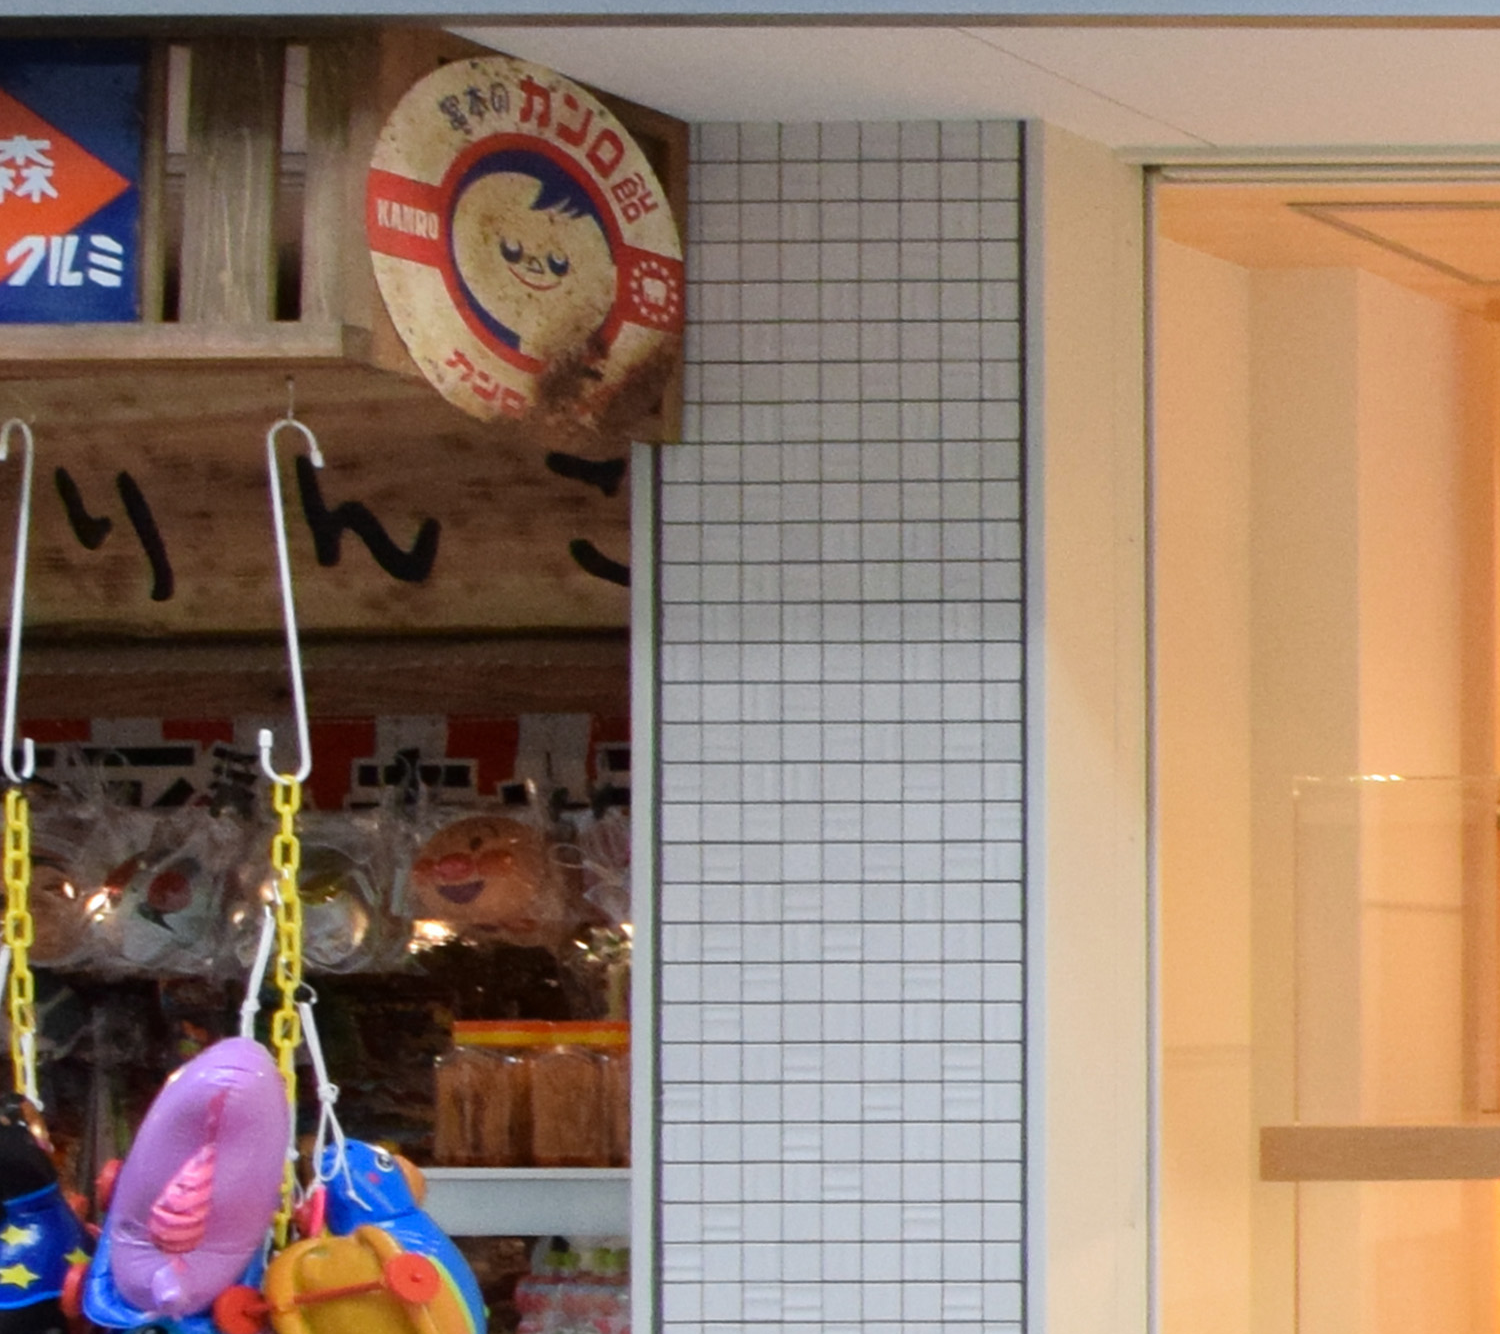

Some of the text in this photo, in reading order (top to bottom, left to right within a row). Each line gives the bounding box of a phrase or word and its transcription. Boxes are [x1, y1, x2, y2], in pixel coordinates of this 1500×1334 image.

[519, 75, 659, 225] カンロ飴
[376, 198, 440, 241] KANRO
[6, 234, 123, 287] クルミ
